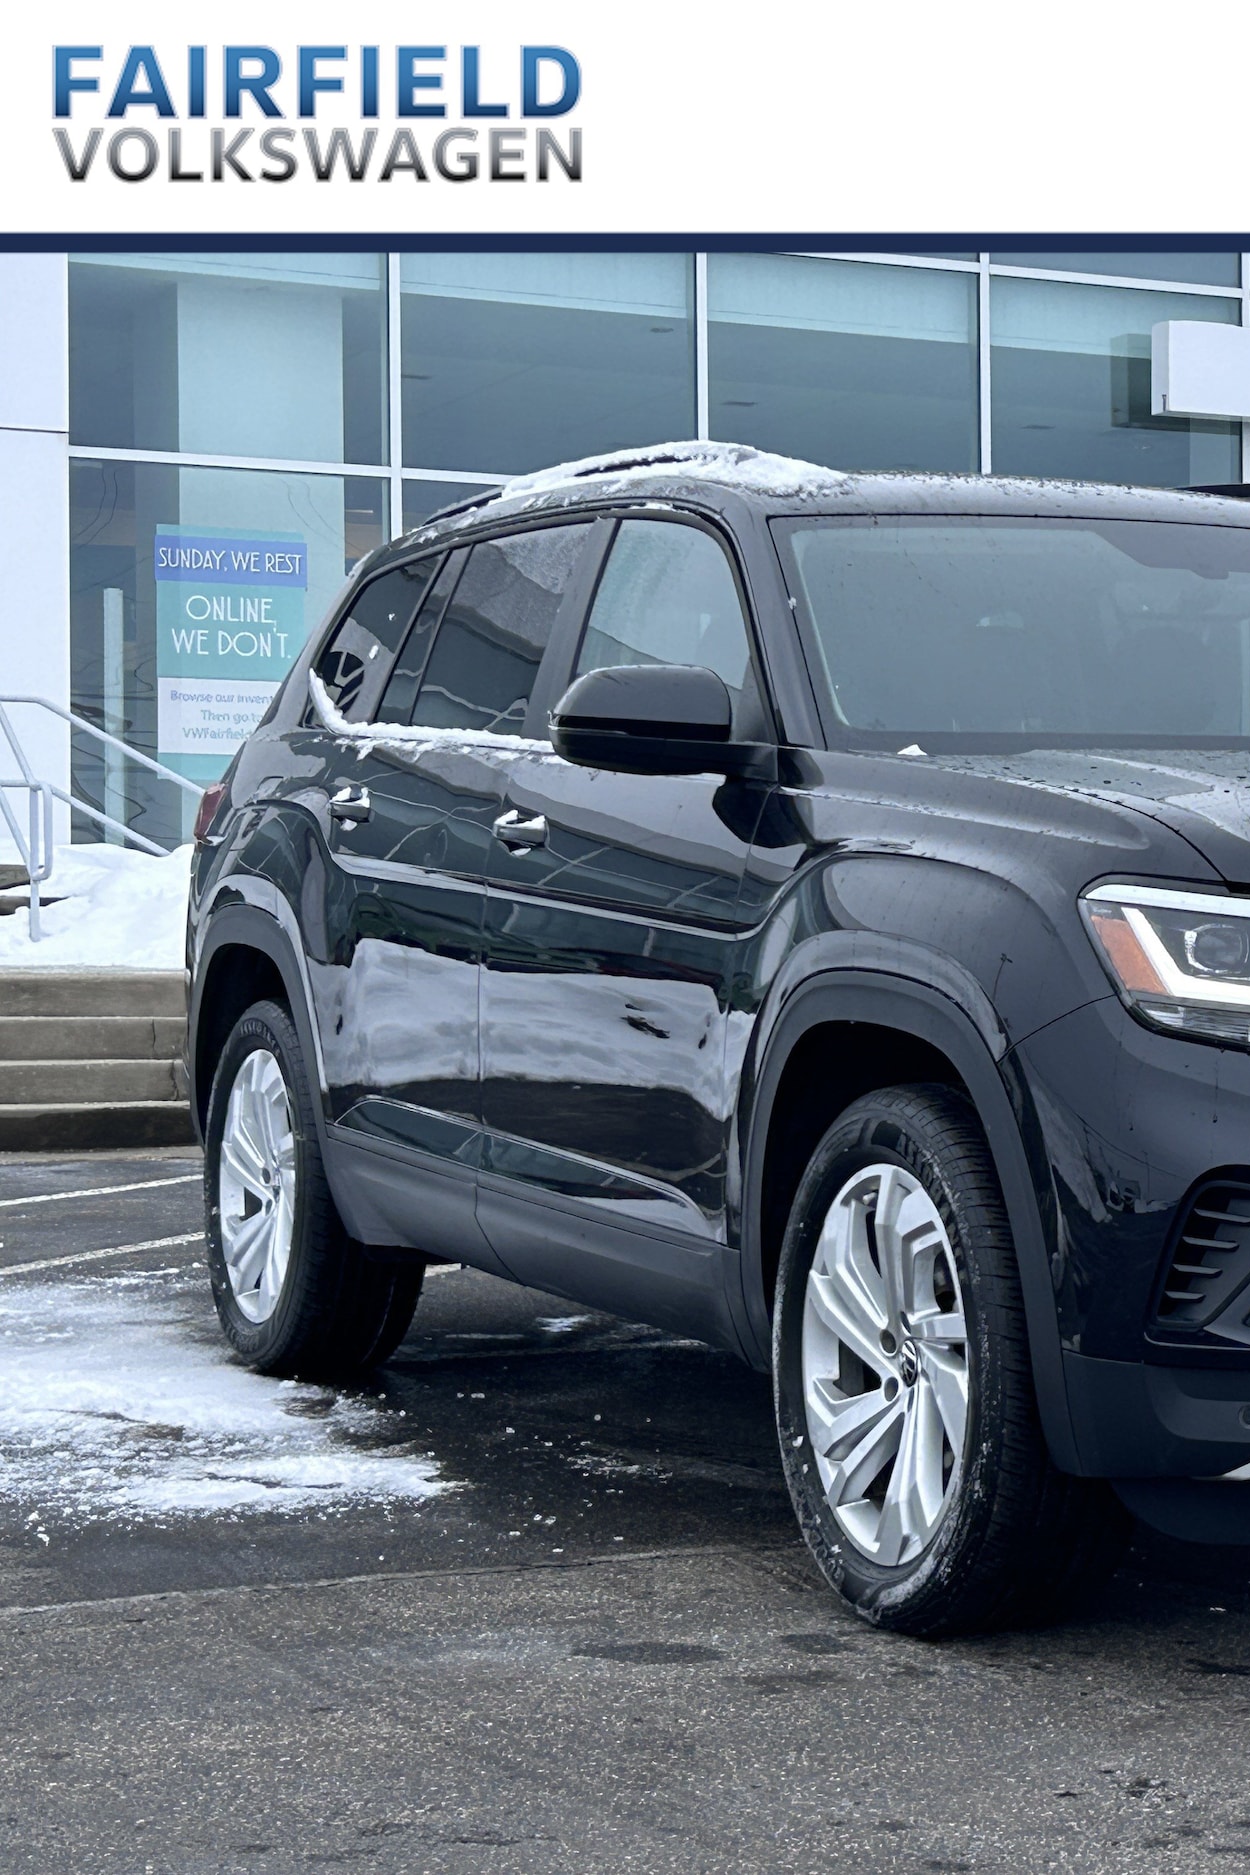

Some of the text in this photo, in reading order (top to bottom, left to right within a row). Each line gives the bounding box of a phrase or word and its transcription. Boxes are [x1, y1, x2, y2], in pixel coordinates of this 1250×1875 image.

[158, 547, 302, 574] SUNDAY, WE REST
[172, 628, 209, 655] WE
[170, 689, 213, 703] Browse
[215, 693, 234, 703] our
[200, 709, 230, 721] Then
[233, 712, 249, 725] go
